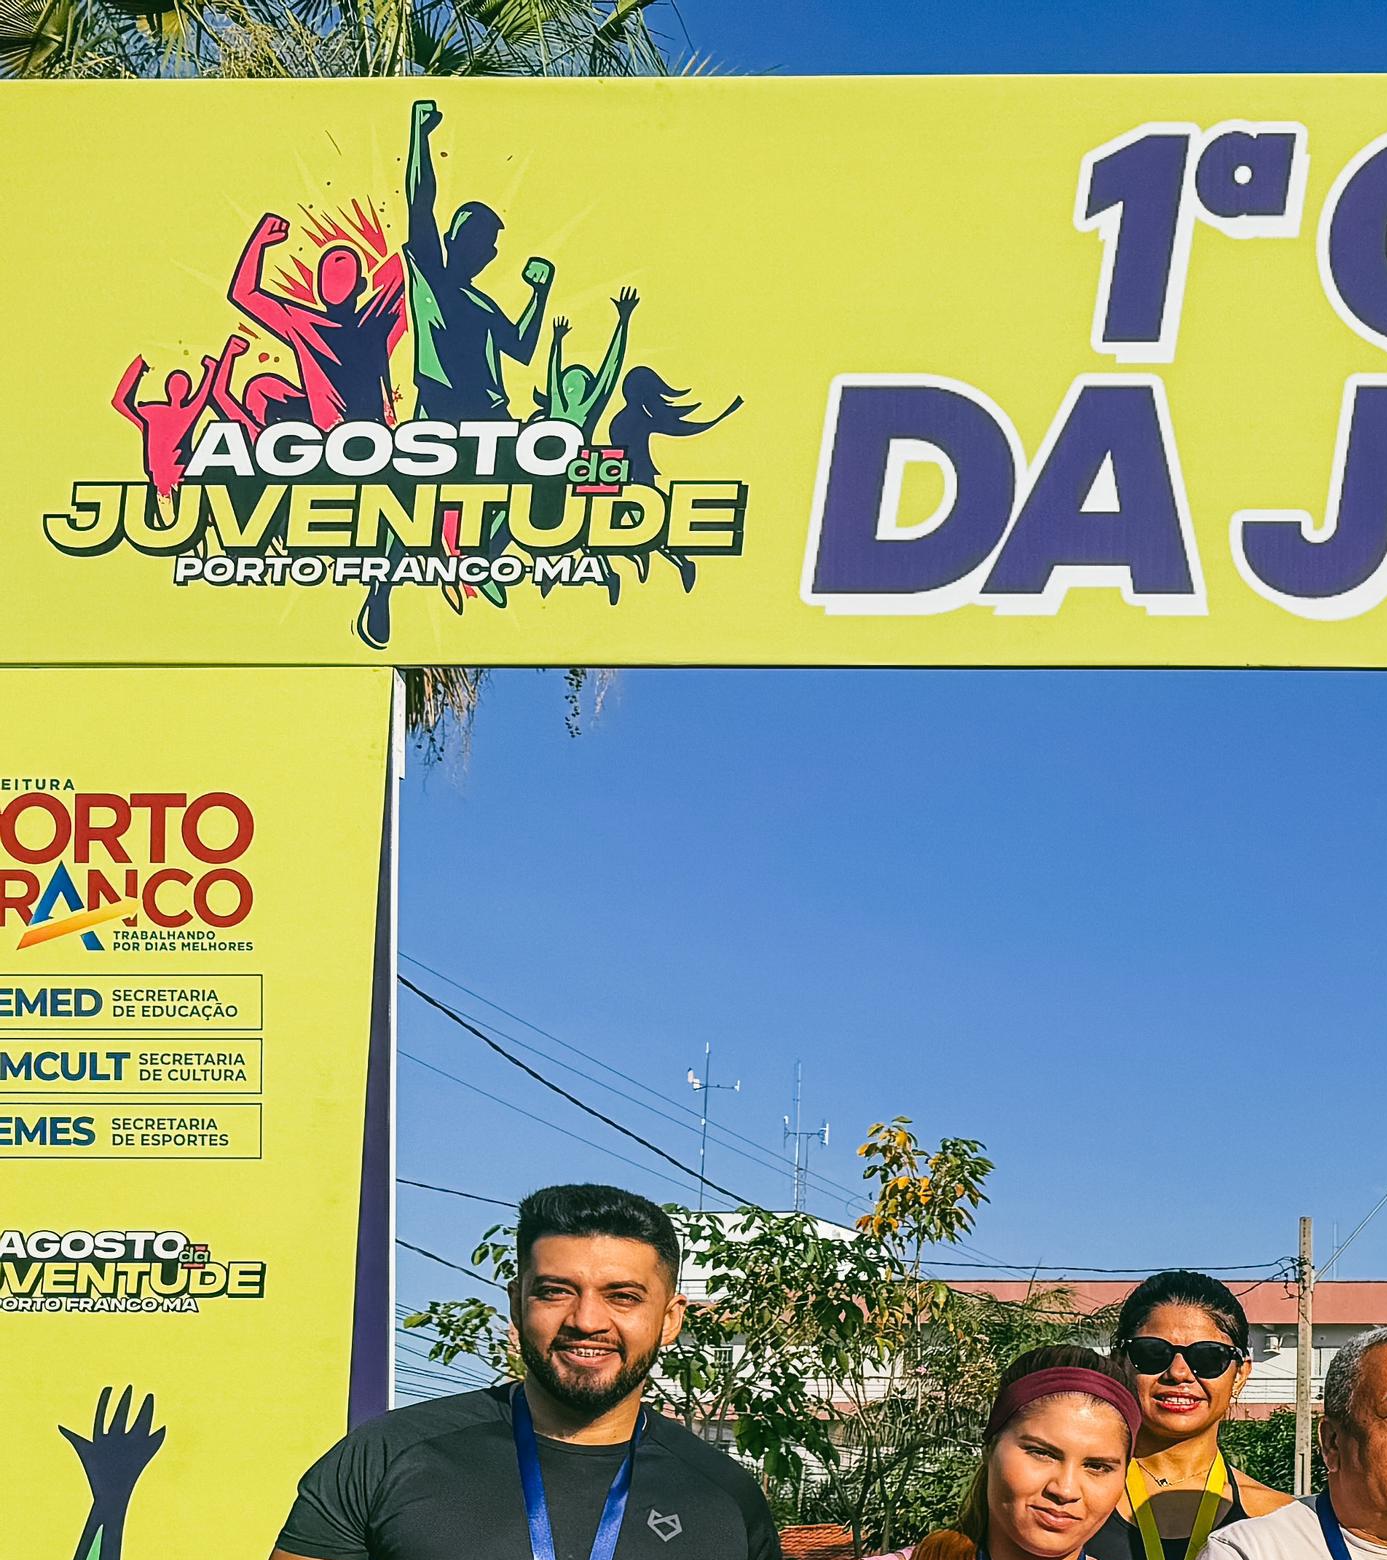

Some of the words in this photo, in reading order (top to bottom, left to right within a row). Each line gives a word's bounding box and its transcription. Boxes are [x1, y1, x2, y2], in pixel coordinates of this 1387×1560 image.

[184, 419, 586, 477] AGOSTO
[567, 450, 630, 486] da
[808, 382, 1197, 596] DA
[43, 480, 747, 556] JUVENTUDE
[175, 556, 325, 584] PORTO
[0, 779, 75, 790] EITURA
[0, 792, 254, 864] ORTO
[0, 860, 254, 930] RANCO
[113, 930, 216, 940] TRABALHANDO
[113, 942, 140, 951] POR
[144, 942, 177, 951] DIAS
[181, 942, 254, 951] MELHORES
[0, 988, 103, 1017] EMED
[112, 989, 219, 1002] SECRETARIA
[112, 1005, 137, 1018] DE
[141, 1002, 239, 1021] EDUCAÇÃO
[0, 1051, 130, 1081] MCULT
[139, 1053, 246, 1066] SECRETARIA
[139, 1068, 163, 1081] DE
[167, 1068, 247, 1081] CULTURA
[0, 1116, 96, 1146] EMES
[111, 1118, 218, 1131] SECRETARIA
[112, 1133, 136, 1146] DE
[140, 1133, 229, 1146] ESPORTES
[0, 1231, 188, 1260] AGOSTO
[179, 1247, 210, 1264] da
[0, 1261, 264, 1295] VENTUDE
[0, 1297, 62, 1312] ORTO
